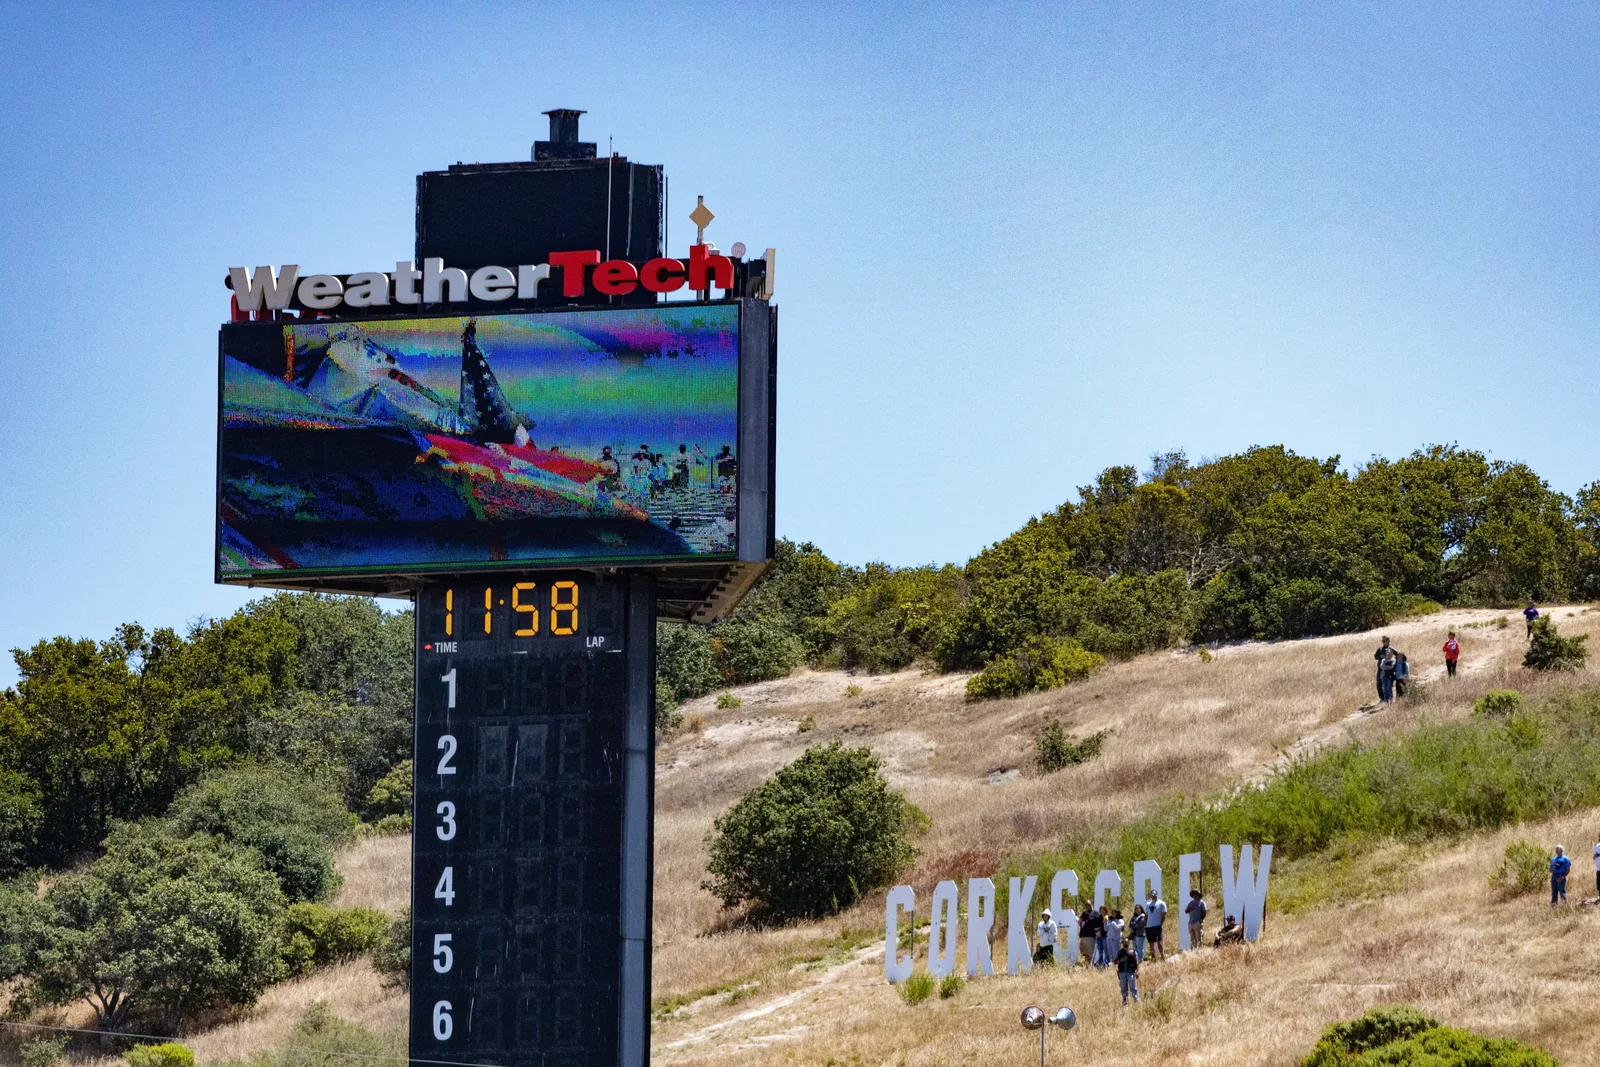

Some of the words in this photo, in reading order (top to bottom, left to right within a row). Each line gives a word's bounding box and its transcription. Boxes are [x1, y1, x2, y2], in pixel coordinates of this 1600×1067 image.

[228, 244, 734, 312] WeatherTech
[434, 642, 458, 653] TIME
[586, 636, 605, 648] LAP
[441, 668, 457, 708] 1
[437, 735, 458, 775] 2
[436, 801, 456, 841] 3
[434, 866, 455, 906] 4
[433, 933, 453, 974] 5
[432, 1000, 453, 1041] 6
